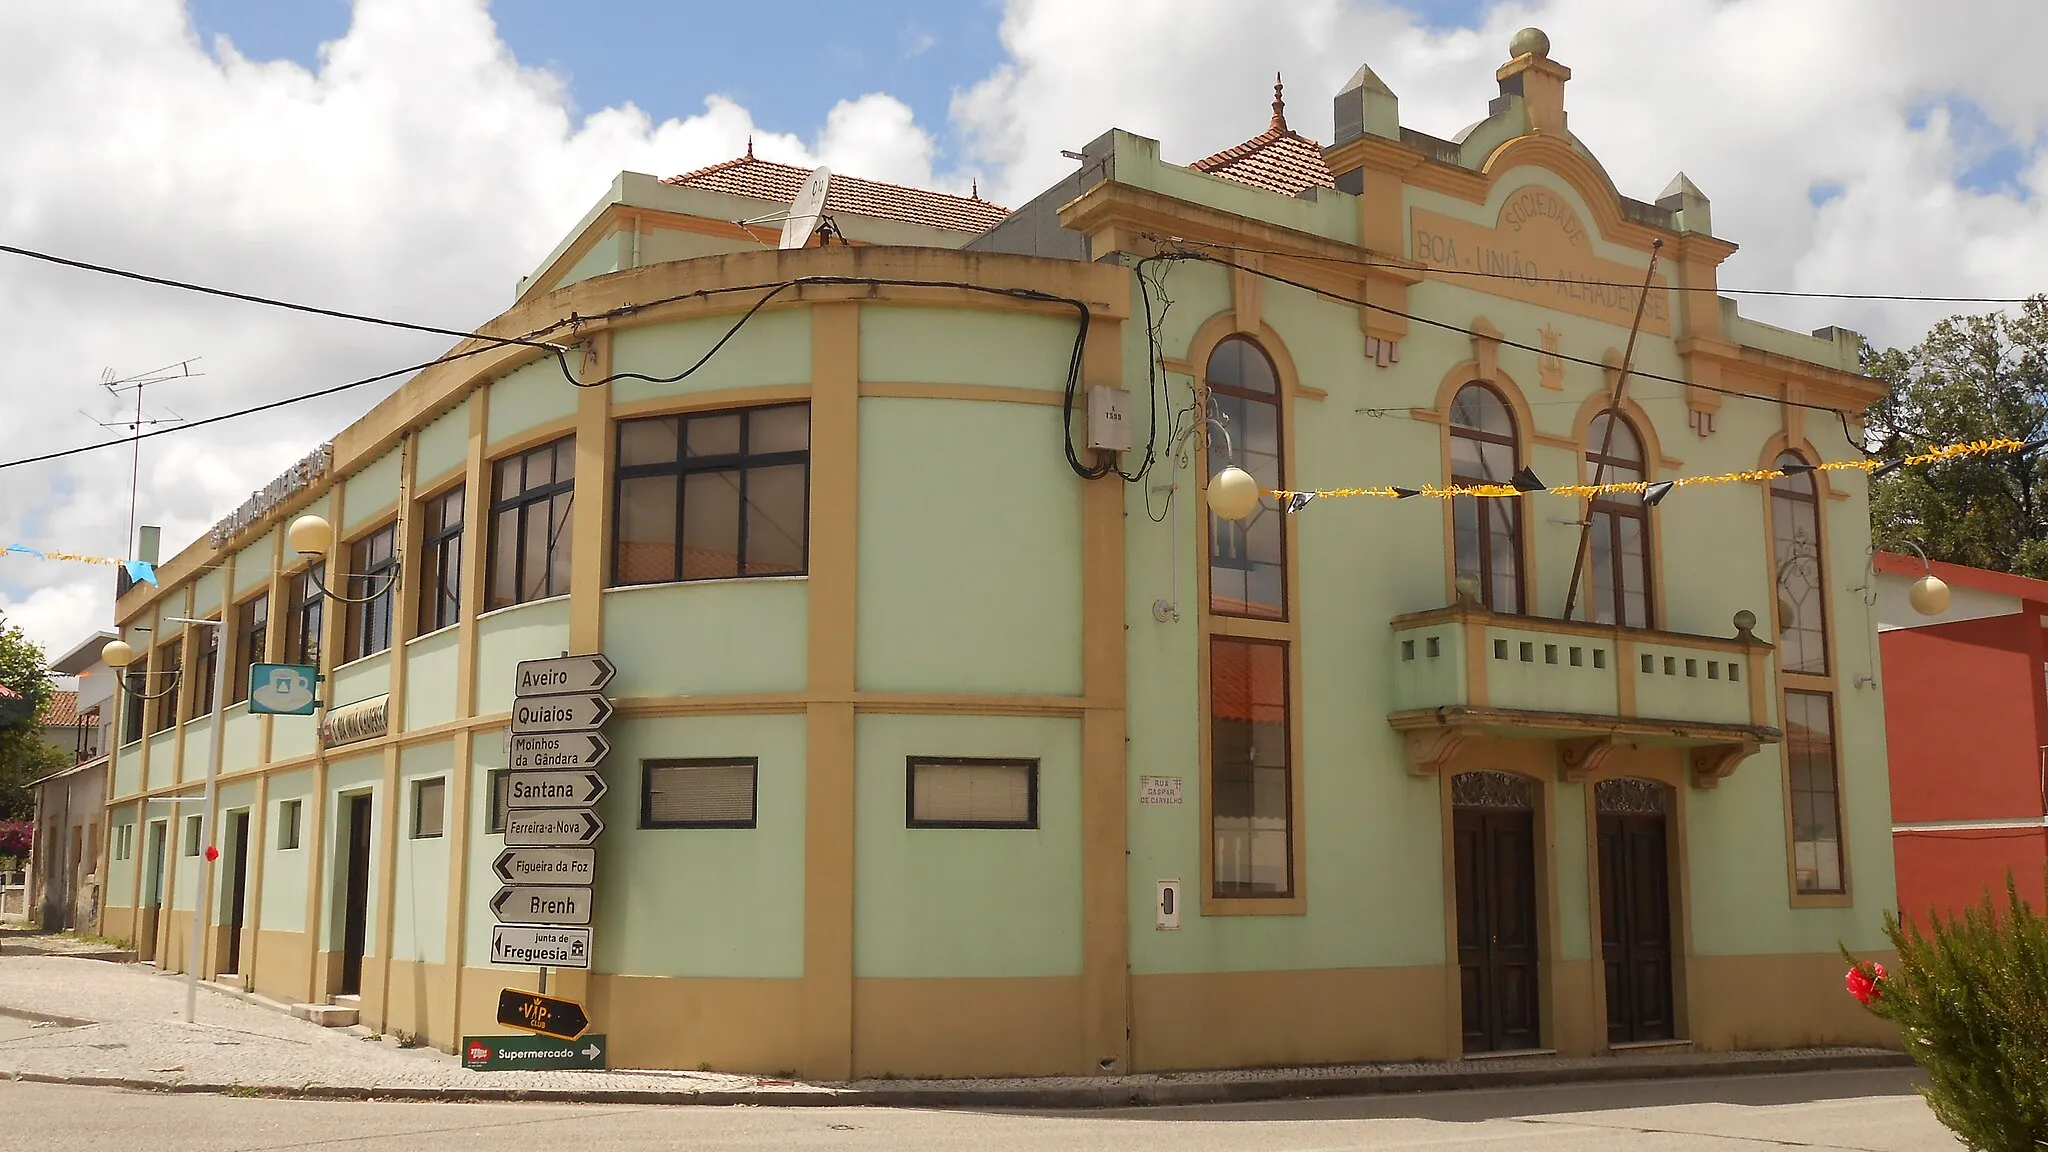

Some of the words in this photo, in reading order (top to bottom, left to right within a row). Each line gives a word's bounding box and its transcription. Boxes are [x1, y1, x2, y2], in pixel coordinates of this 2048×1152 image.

[1505, 191, 1585, 248] SOCIEDADE
[1417, 230, 1458, 270] BOA
[1476, 246, 1538, 287] UNIÃO
[1556, 268, 1667, 322] ALHADENSE
[521, 668, 568, 688] Aveiro
[518, 705, 573, 725] Quiaios
[516, 737, 560, 751] Moinhos
[515, 754, 528, 767] da
[534, 752, 578, 766] Gândara
[513, 781, 574, 799] Santana
[1154, 779, 1169, 787] RUA
[516, 860, 553, 874] Figueira
[555, 861, 568, 873] da
[571, 860, 588, 872] Foz
[530, 896, 575, 914] Brenh
[535, 933, 556, 944] junta
[558, 933, 569, 943] de
[504, 944, 568, 962] Freguesia
[524, 1002, 547, 1021] VIP
[530, 1019, 546, 1029] CLUB
[498, 1048, 575, 1062] Supermercado
